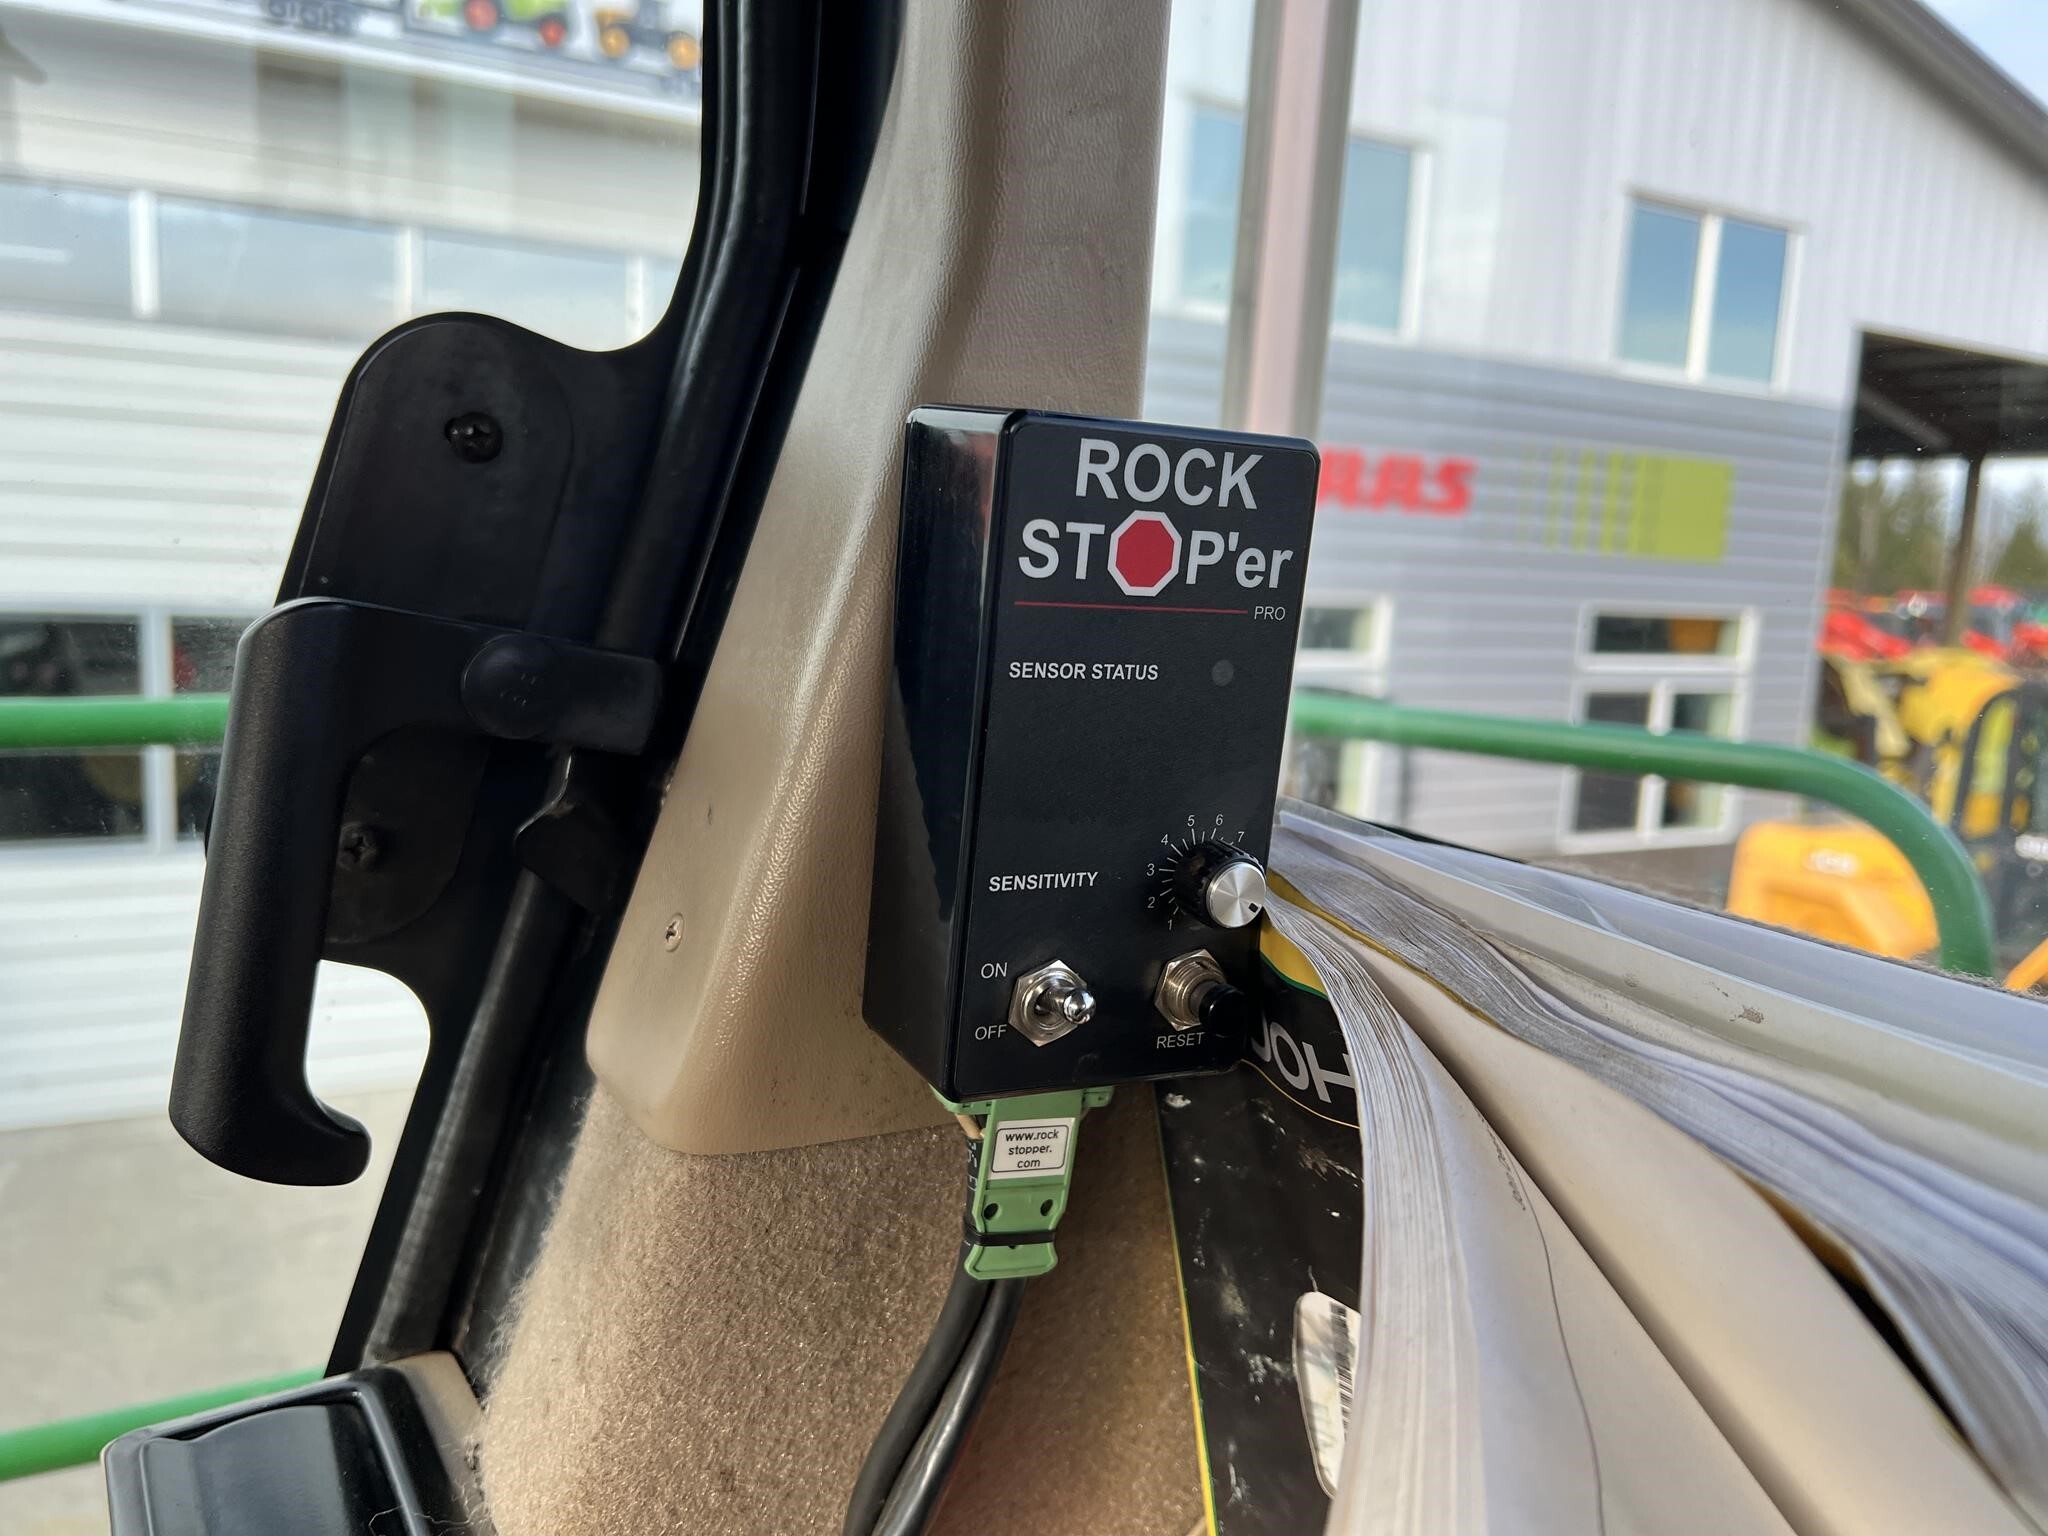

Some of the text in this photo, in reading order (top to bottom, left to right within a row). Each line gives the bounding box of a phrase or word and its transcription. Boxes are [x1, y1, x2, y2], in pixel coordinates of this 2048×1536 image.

[1075, 437, 1263, 511] ROCK
[1253, 605, 1287, 621] PRO
[1008, 661, 1160, 681] SENSOR STATUS
[1187, 814, 1196, 827] 5
[1215, 813, 1225, 826] 6
[1160, 833, 1170, 846] 4
[1237, 831, 1246, 843] 7
[1146, 863, 1156, 876] 3
[988, 871, 1100, 893] SENSITIVITY
[1147, 896, 1157, 909] 2
[980, 961, 1009, 979] ON
[974, 1023, 1008, 1042] OFF
[1156, 1031, 1205, 1049] RESET
[1005, 1129, 1060, 1142] www.rock
[1008, 1144, 1053, 1156] stopper.
[1017, 1158, 1041, 1169] com
